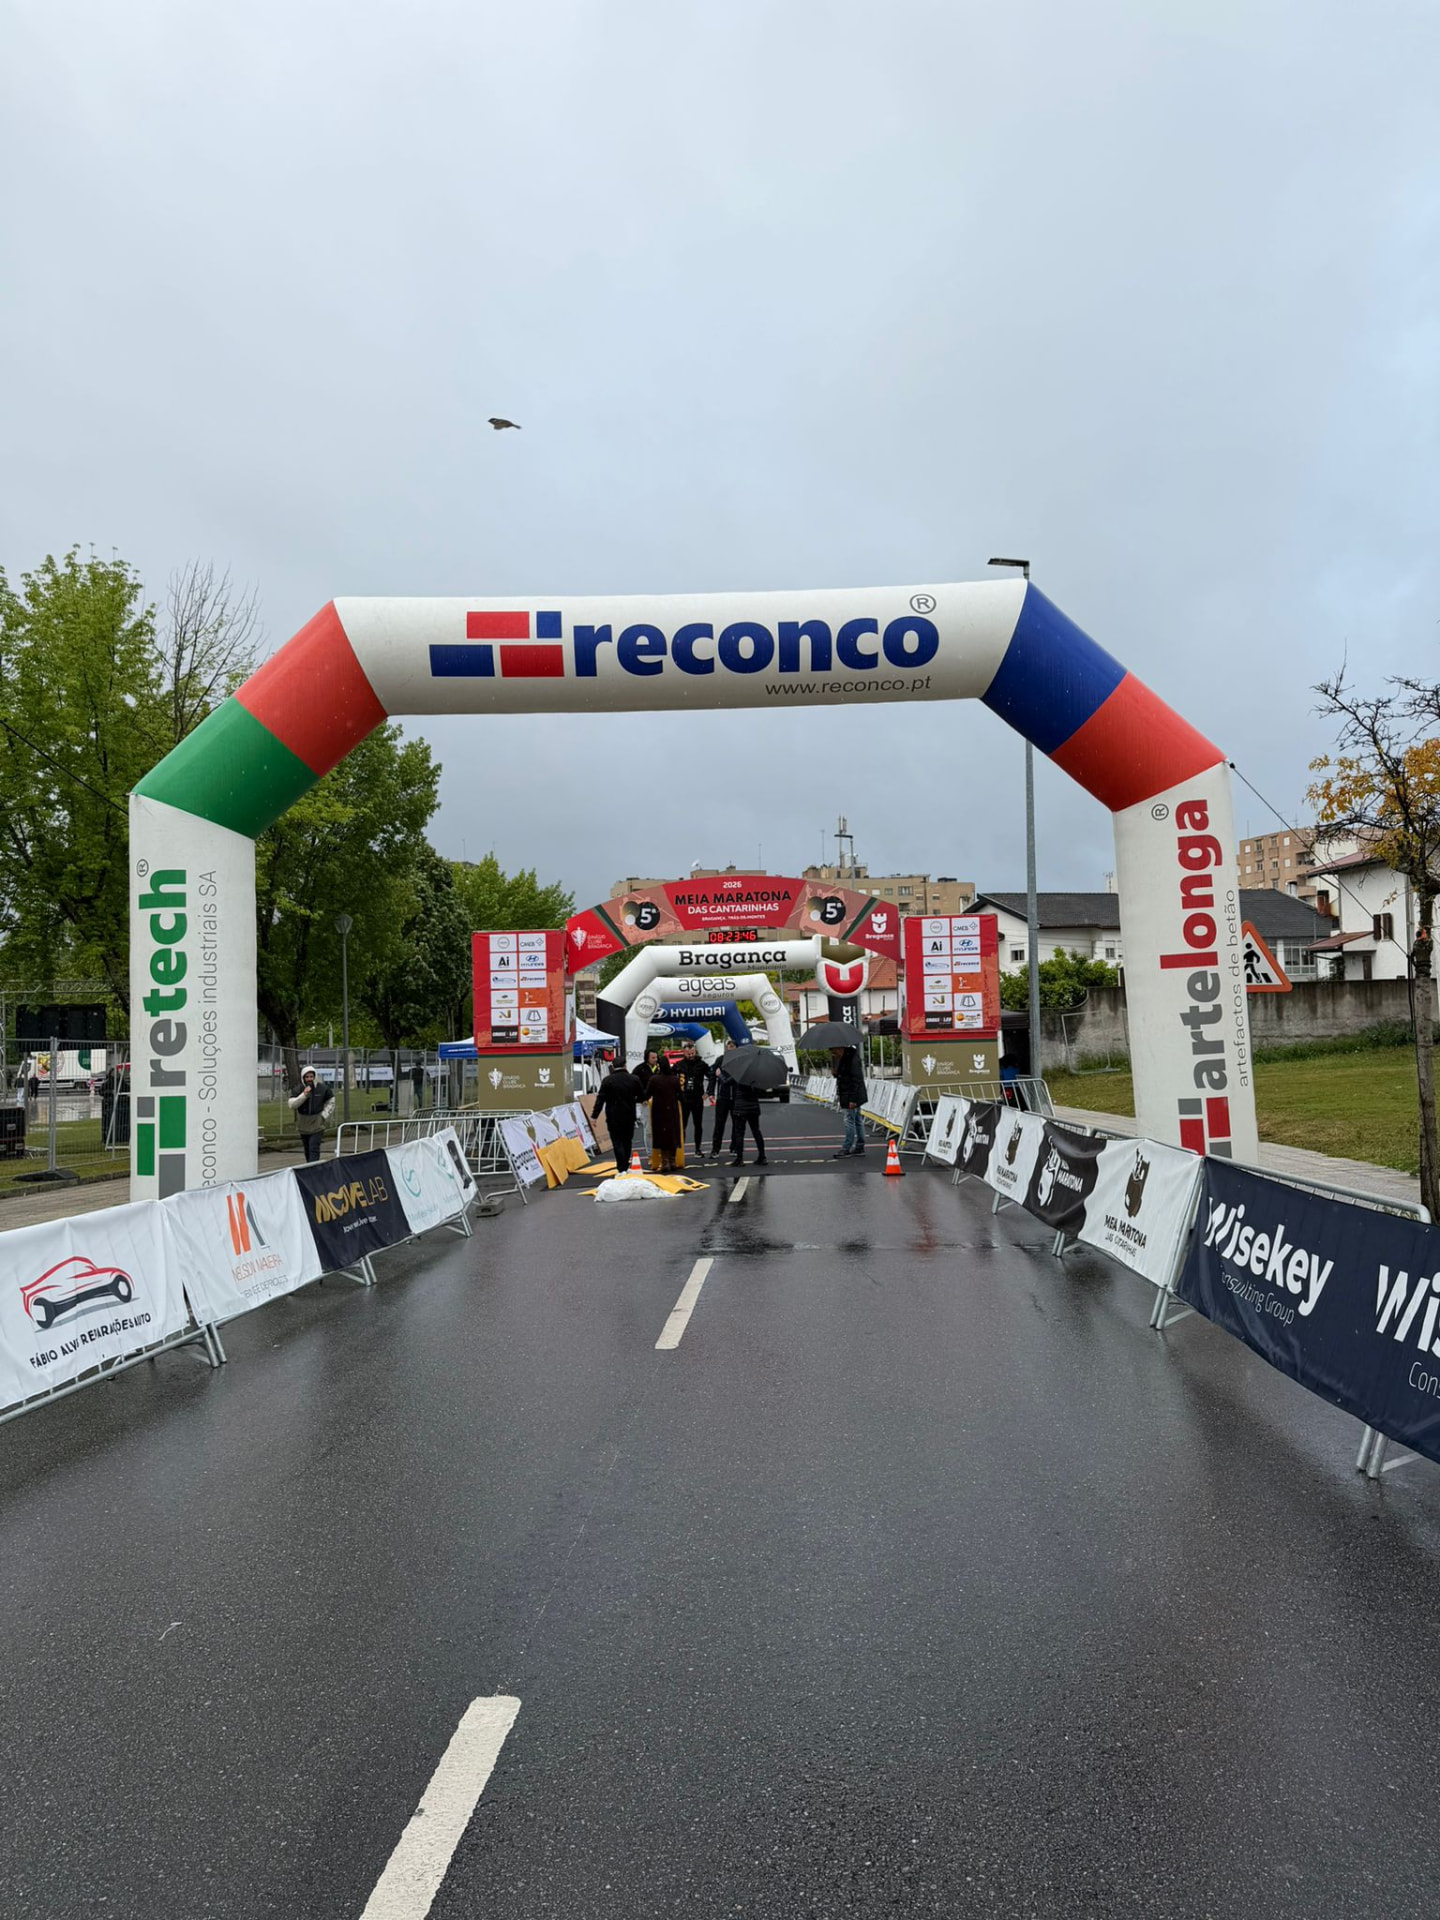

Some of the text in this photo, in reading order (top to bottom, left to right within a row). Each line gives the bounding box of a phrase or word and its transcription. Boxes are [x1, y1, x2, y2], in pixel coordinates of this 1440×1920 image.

[573, 615, 940, 677] reconco
[765, 675, 932, 697] www.reconco.pt
[198, 870, 218, 897] SA
[723, 881, 742, 889] 2026
[674, 890, 791, 905] MEIA MARATONA
[688, 903, 779, 915] DAS CANTARINHAS
[709, 931, 756, 943] 08:23:46
[1159, 799, 1229, 1091] artelonga
[197, 903, 218, 1003] industriais
[678, 950, 787, 969] Bragança
[138, 869, 188, 1087] retech
[678, 977, 736, 998] ageas
[1224, 890, 1248, 1087] artefactos de betão
[702, 991, 735, 999] seguros
[670, 1006, 726, 1018] HYUNDAI
[198, 1009, 221, 1101] Soluções
[1203, 1197, 1335, 1317] Wisekey
[1265, 1292, 1295, 1328] Group
[30, 1348, 58, 1369] FÁBIO
